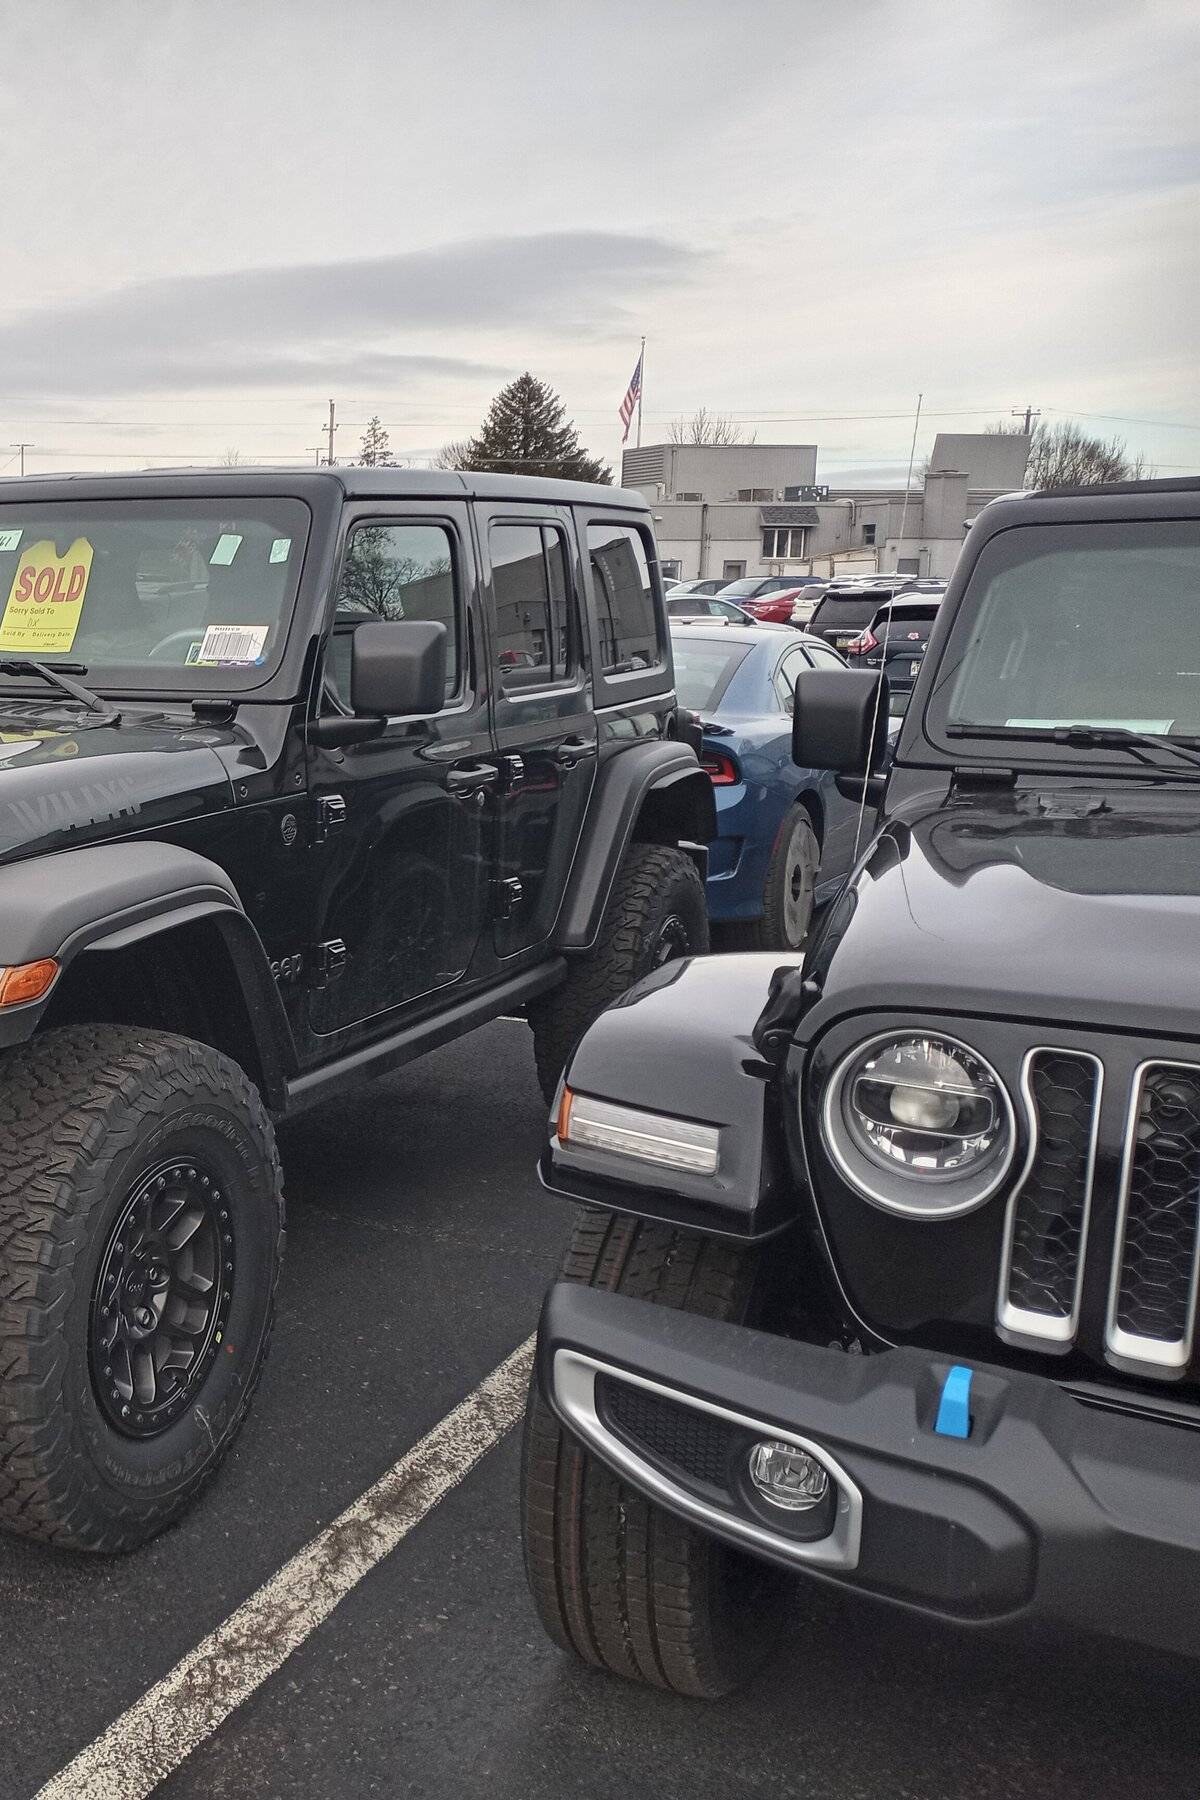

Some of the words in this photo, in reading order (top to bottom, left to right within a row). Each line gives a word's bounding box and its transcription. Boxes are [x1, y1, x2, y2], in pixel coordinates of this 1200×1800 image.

[15, 565, 86, 603] SOLD
[9, 606, 28, 615] Sorry
[30, 607, 45, 615] Sold
[46, 607, 55, 615] To
[271, 953, 302, 982] eep
